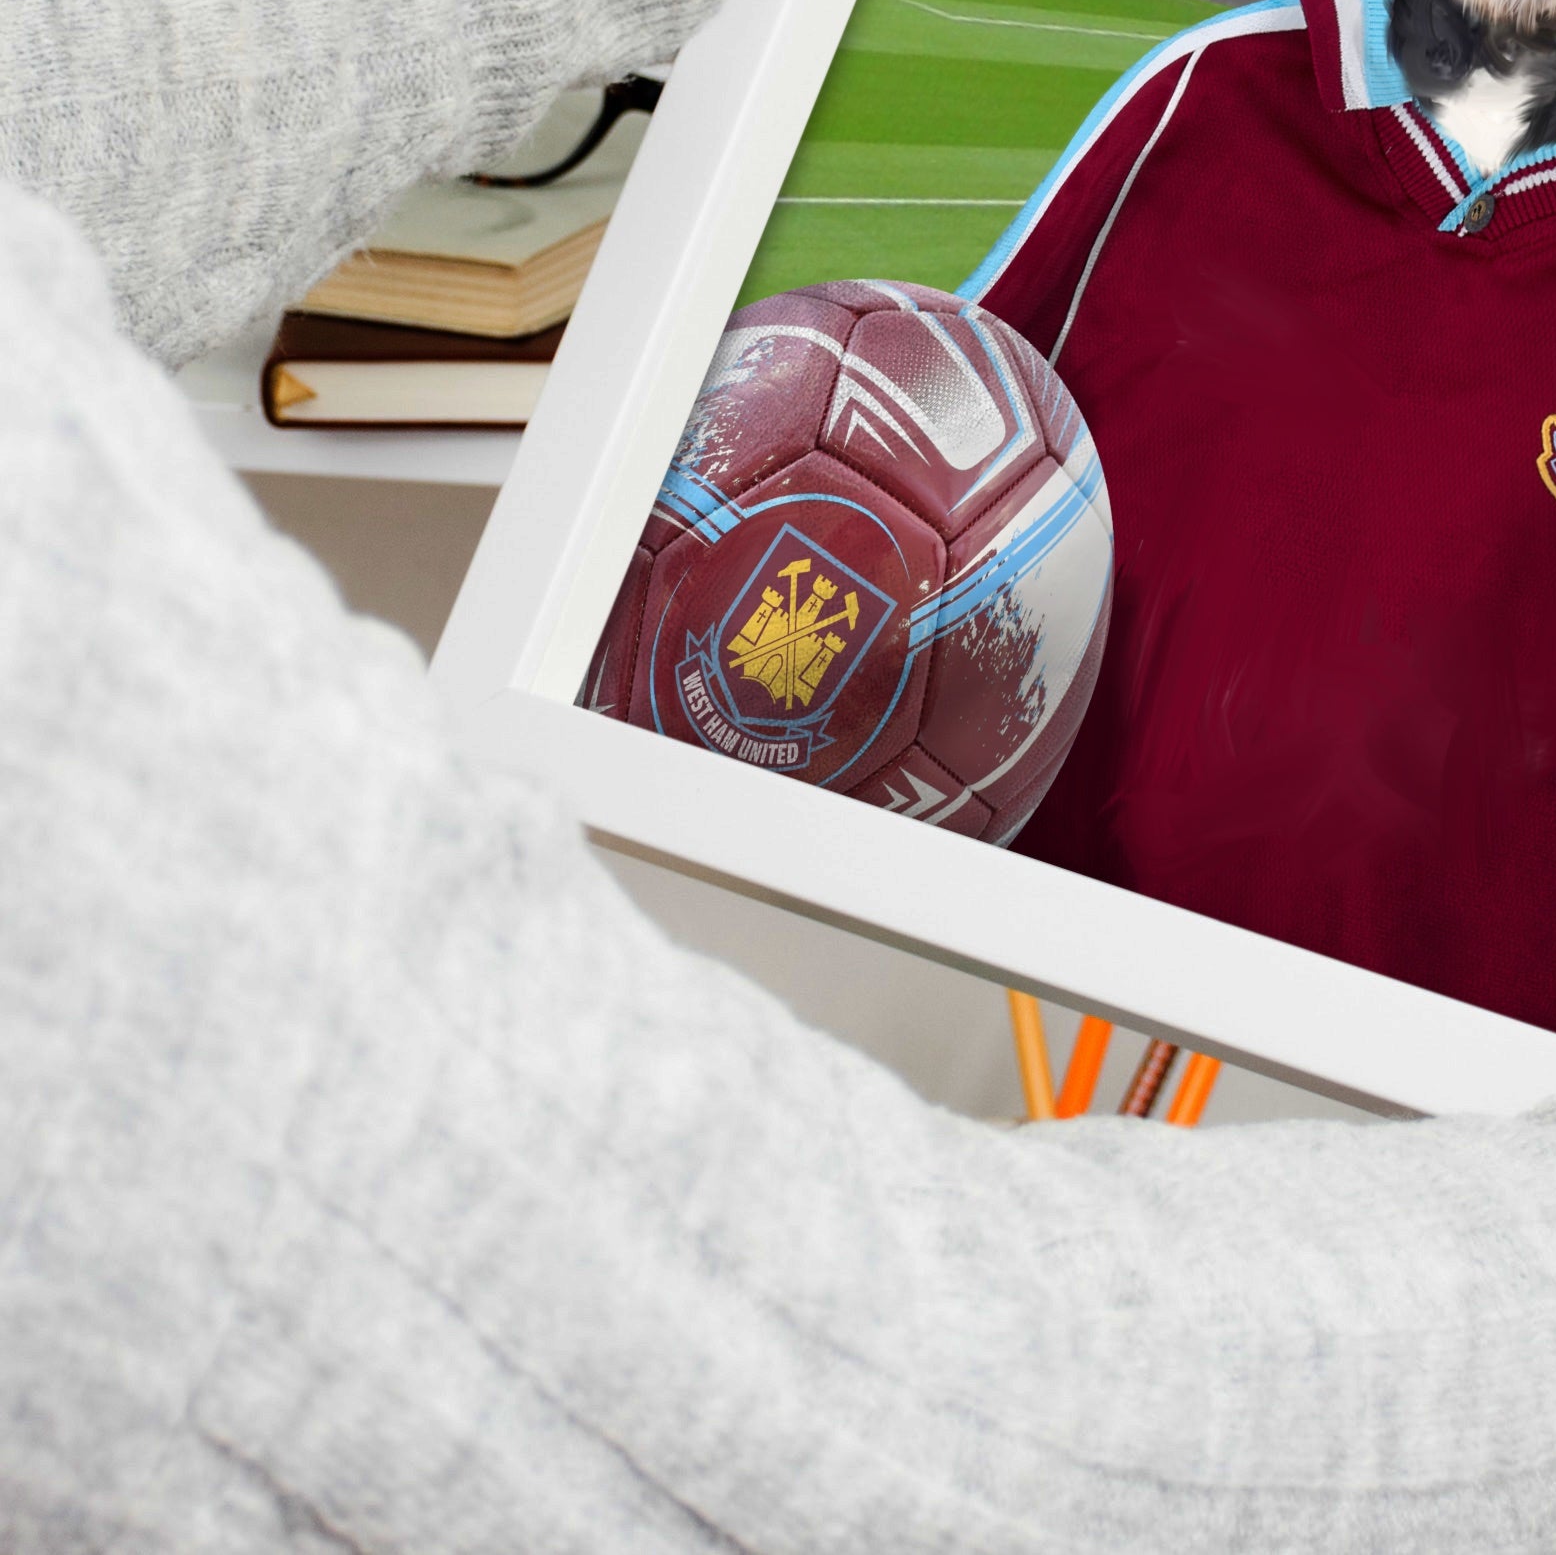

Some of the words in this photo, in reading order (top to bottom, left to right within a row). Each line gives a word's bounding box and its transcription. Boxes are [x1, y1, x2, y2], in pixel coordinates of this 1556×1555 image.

[682, 669, 715, 721] WEST
[702, 712, 741, 753] HAM
[737, 737, 800, 765] UNITED
